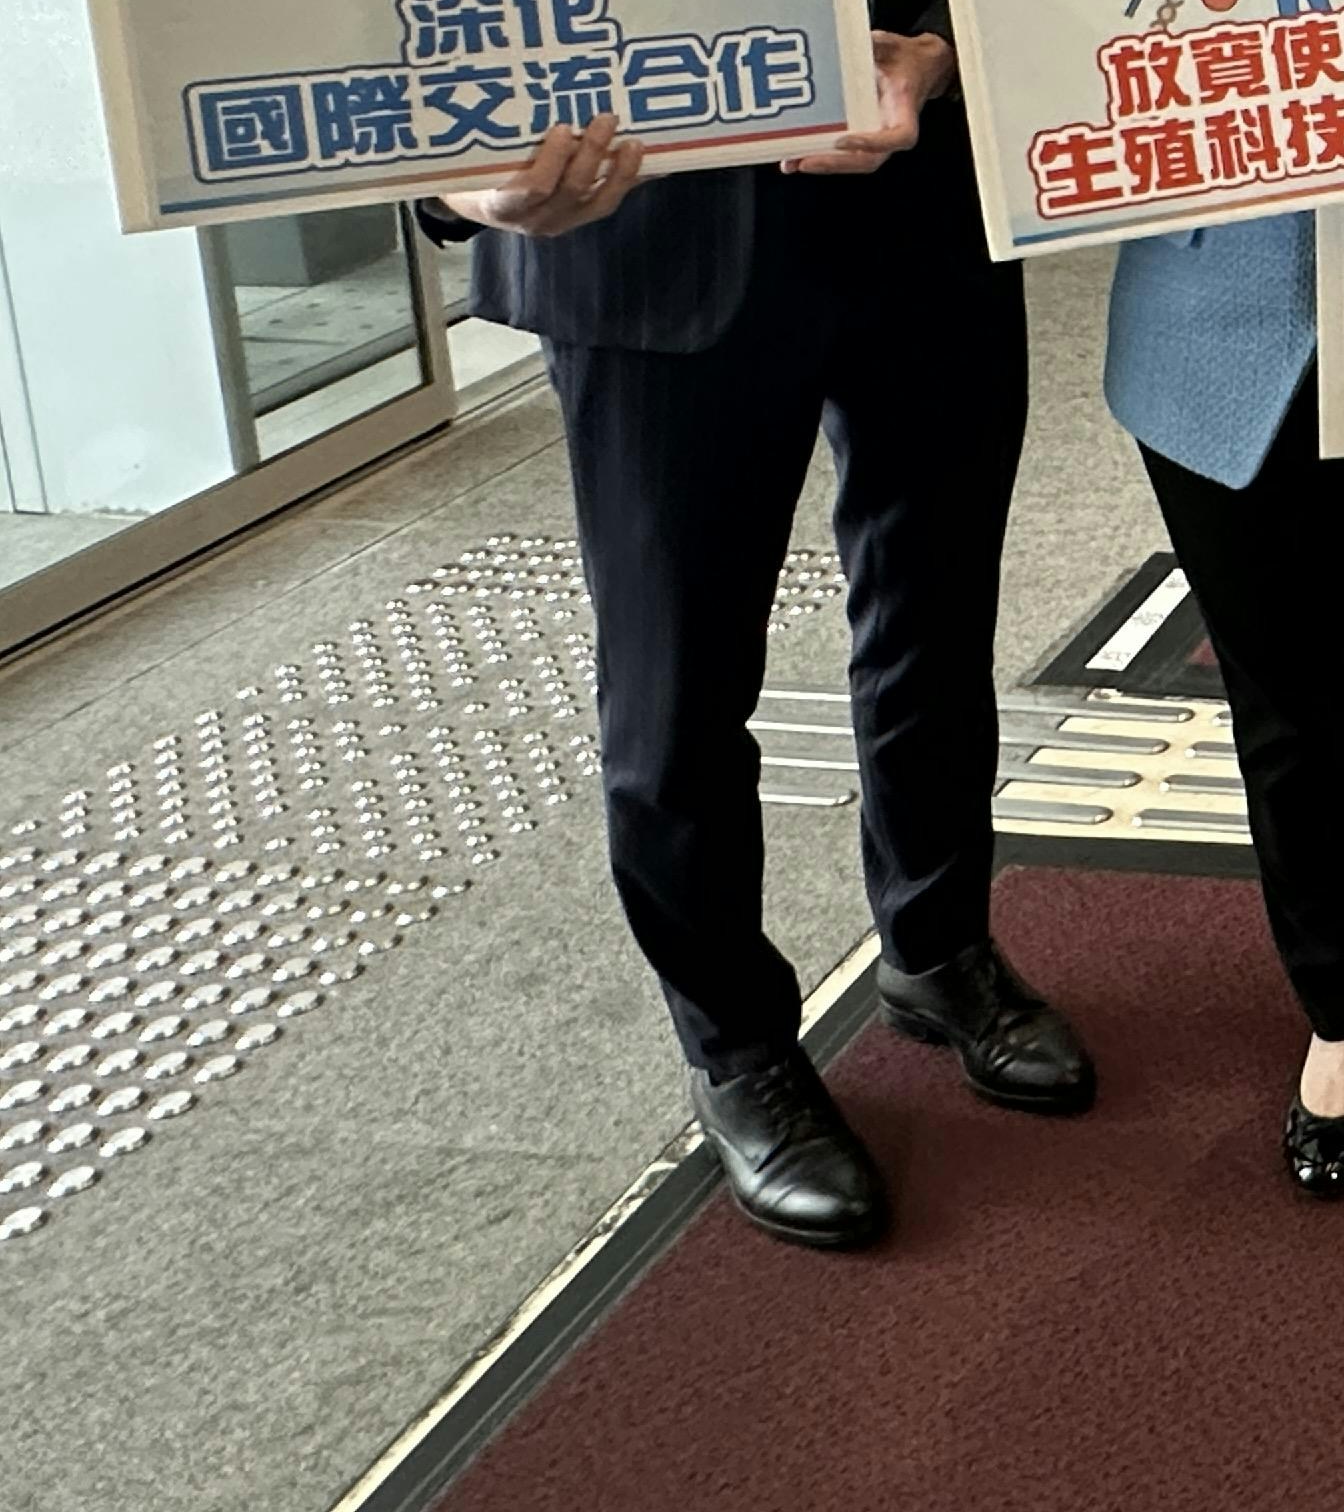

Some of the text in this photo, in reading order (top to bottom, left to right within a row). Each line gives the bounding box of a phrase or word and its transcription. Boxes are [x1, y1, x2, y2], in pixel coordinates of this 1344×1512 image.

[199, 35, 811, 172] 國際交流合作
